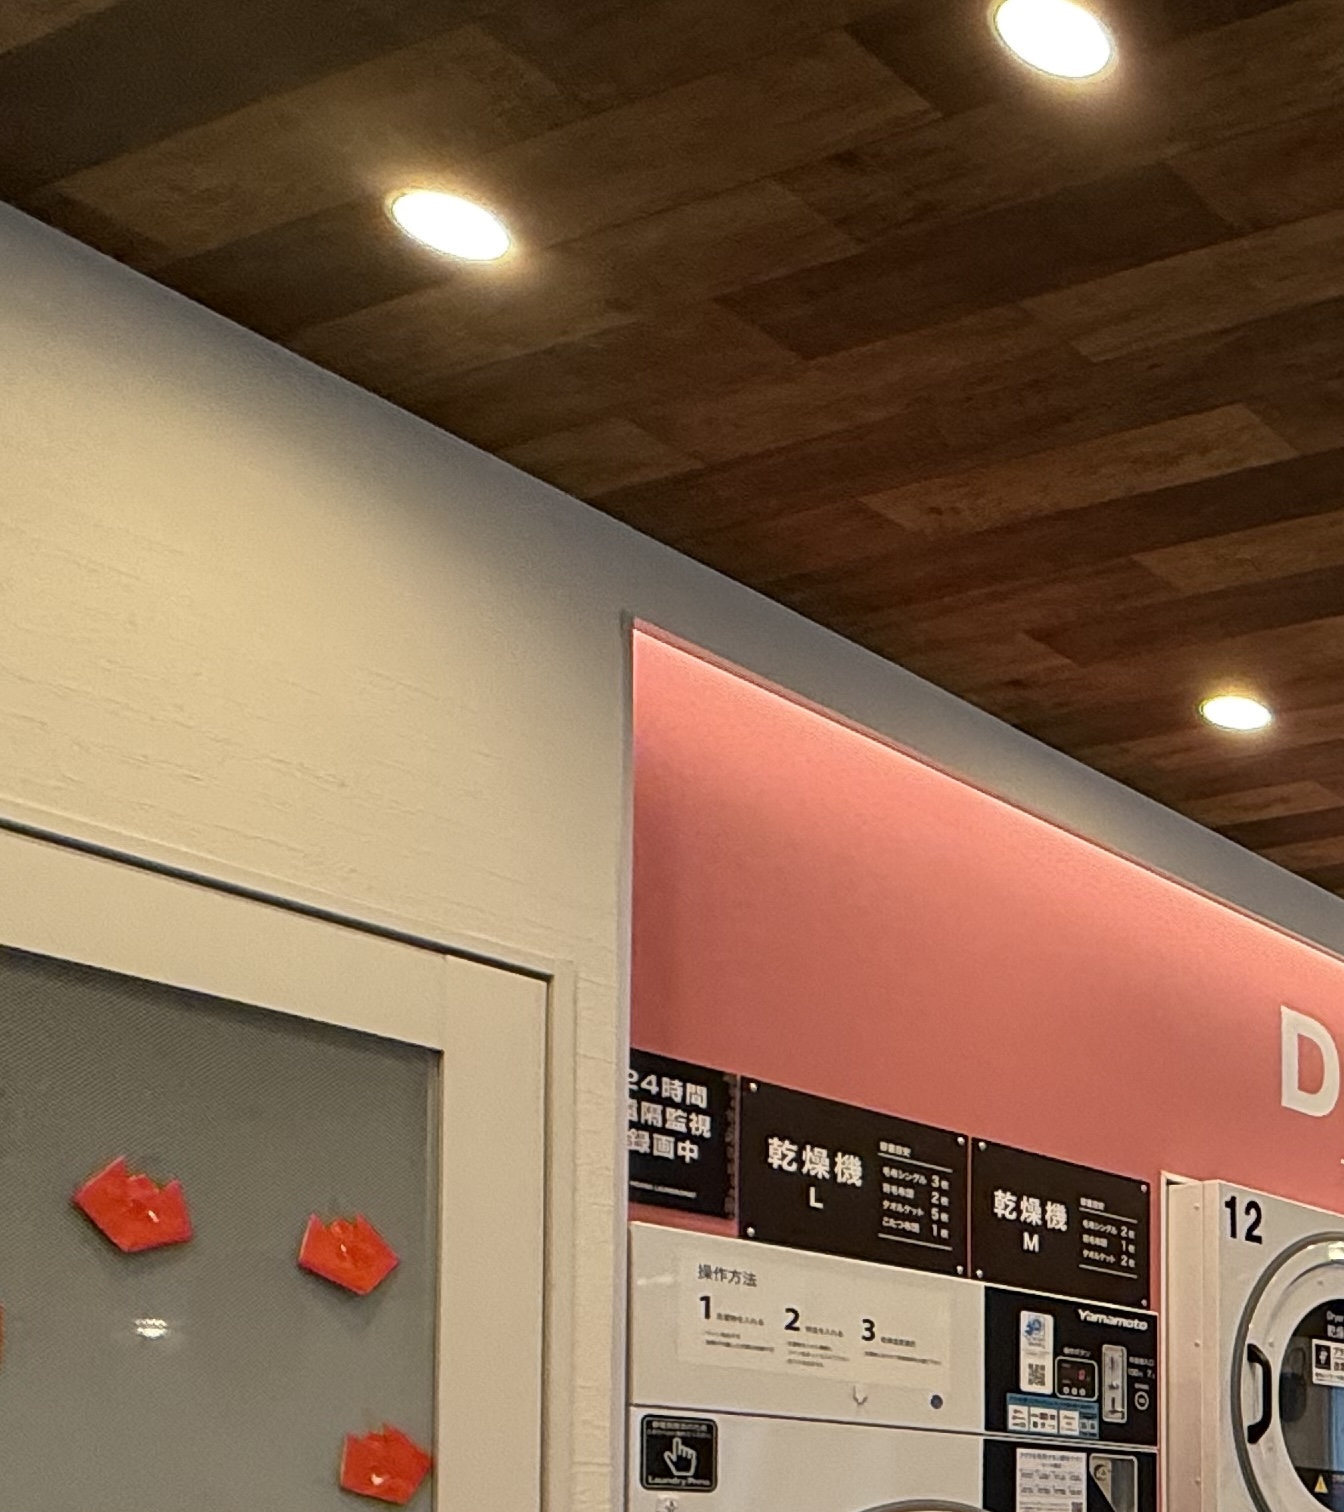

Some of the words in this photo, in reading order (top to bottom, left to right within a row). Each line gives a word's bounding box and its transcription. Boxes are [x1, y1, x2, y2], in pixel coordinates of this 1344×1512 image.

[767, 1136, 864, 1189] 乾燥機
[809, 1186, 824, 1210] L
[993, 1188, 1068, 1232] 乾燥機
[1225, 1195, 1262, 1244] 12
[1022, 1232, 1040, 1253] M
[698, 1264, 757, 1287] 操作方法
[699, 1295, 711, 1320] 1
[1078, 1308, 1148, 1331] Yamamoto
[784, 1308, 801, 1332] 2
[862, 1319, 875, 1342] 3
